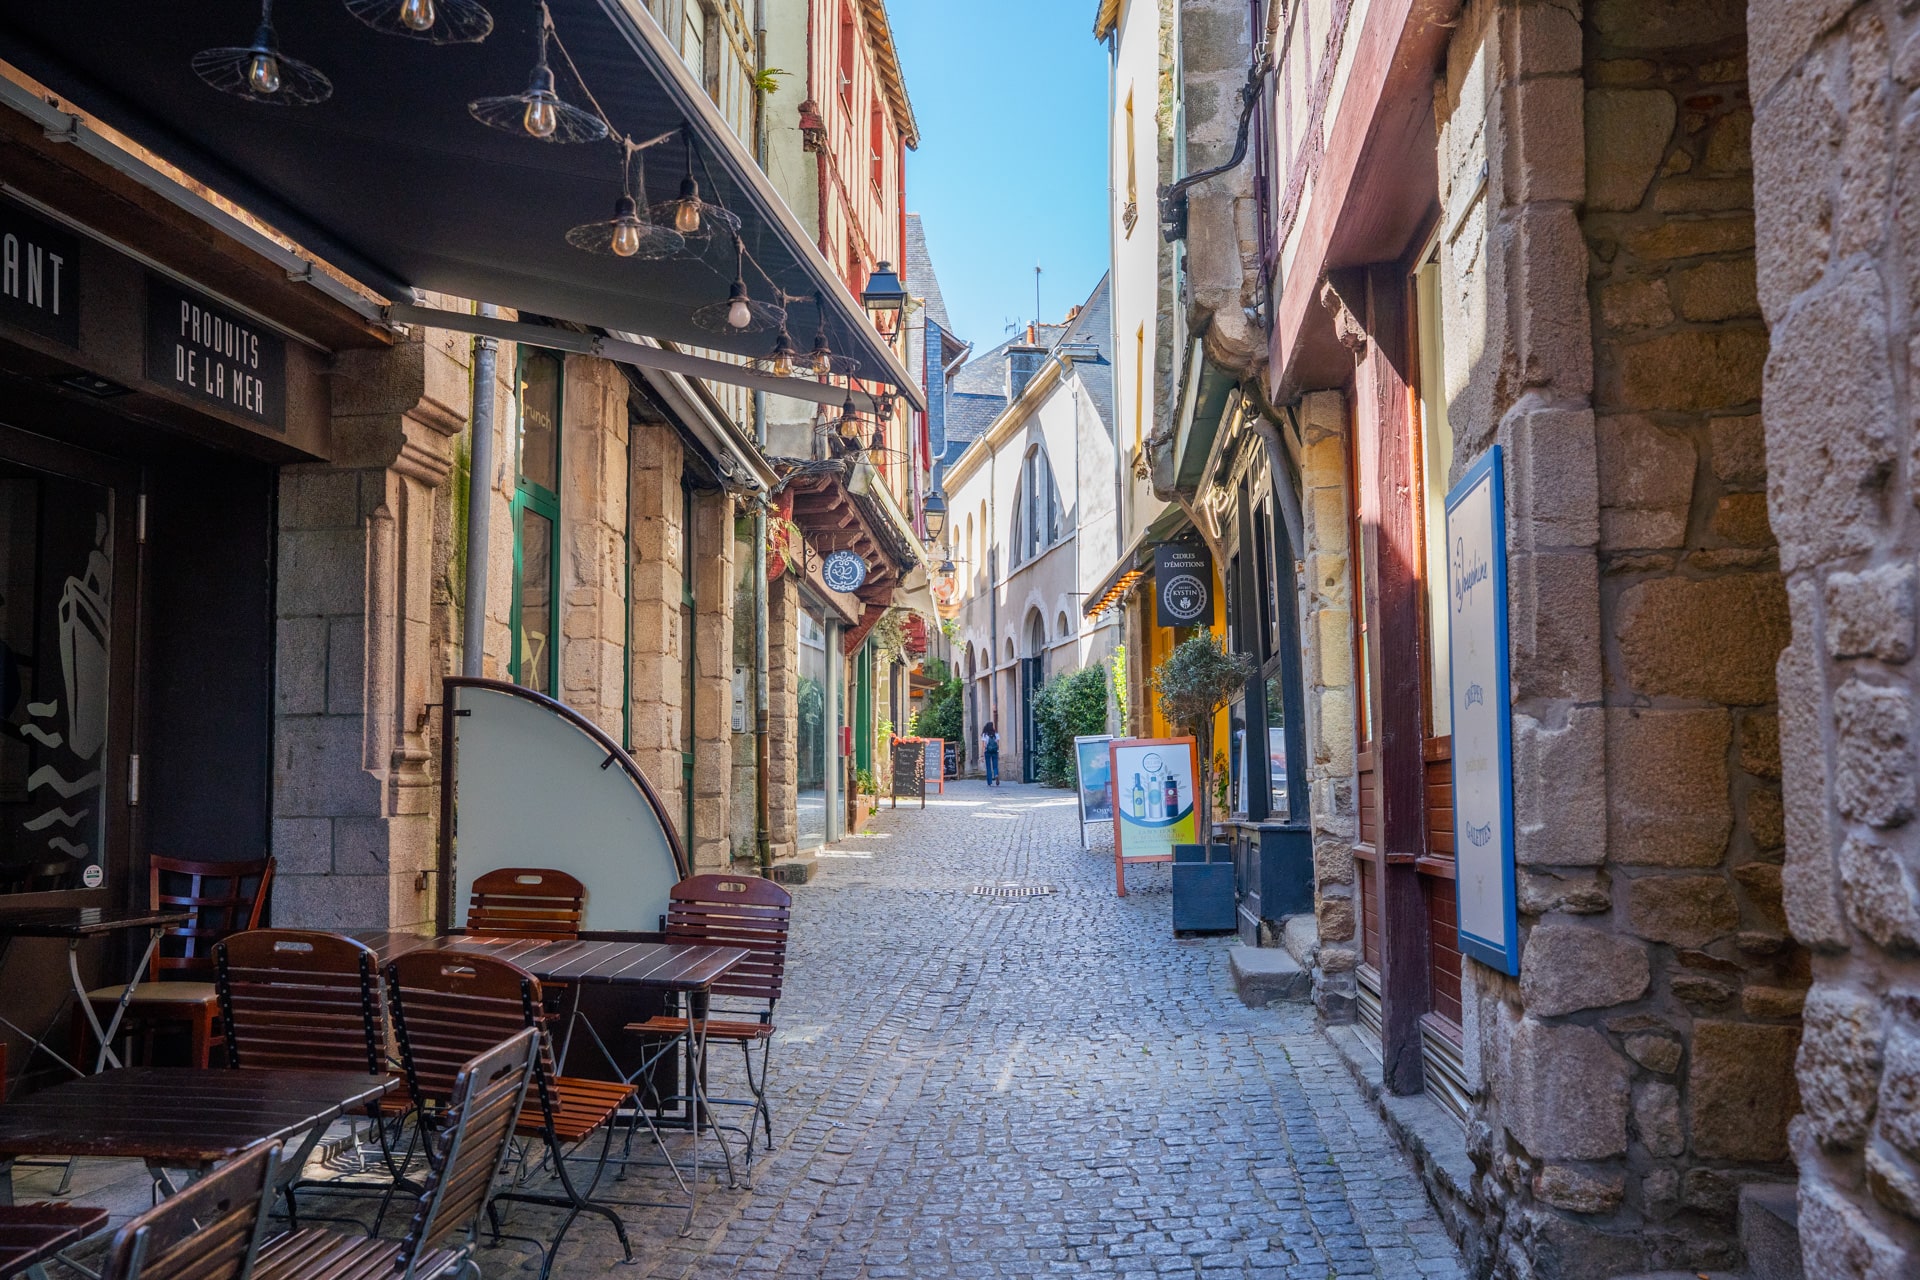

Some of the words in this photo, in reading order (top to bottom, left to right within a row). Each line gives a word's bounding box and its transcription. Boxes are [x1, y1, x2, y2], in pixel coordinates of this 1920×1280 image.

[3, 233, 64, 316] ANT
[181, 299, 259, 370] PRODUITS
[176, 344, 197, 388] DE
[205, 357, 224, 399] LA
[233, 369, 263, 415] MER
